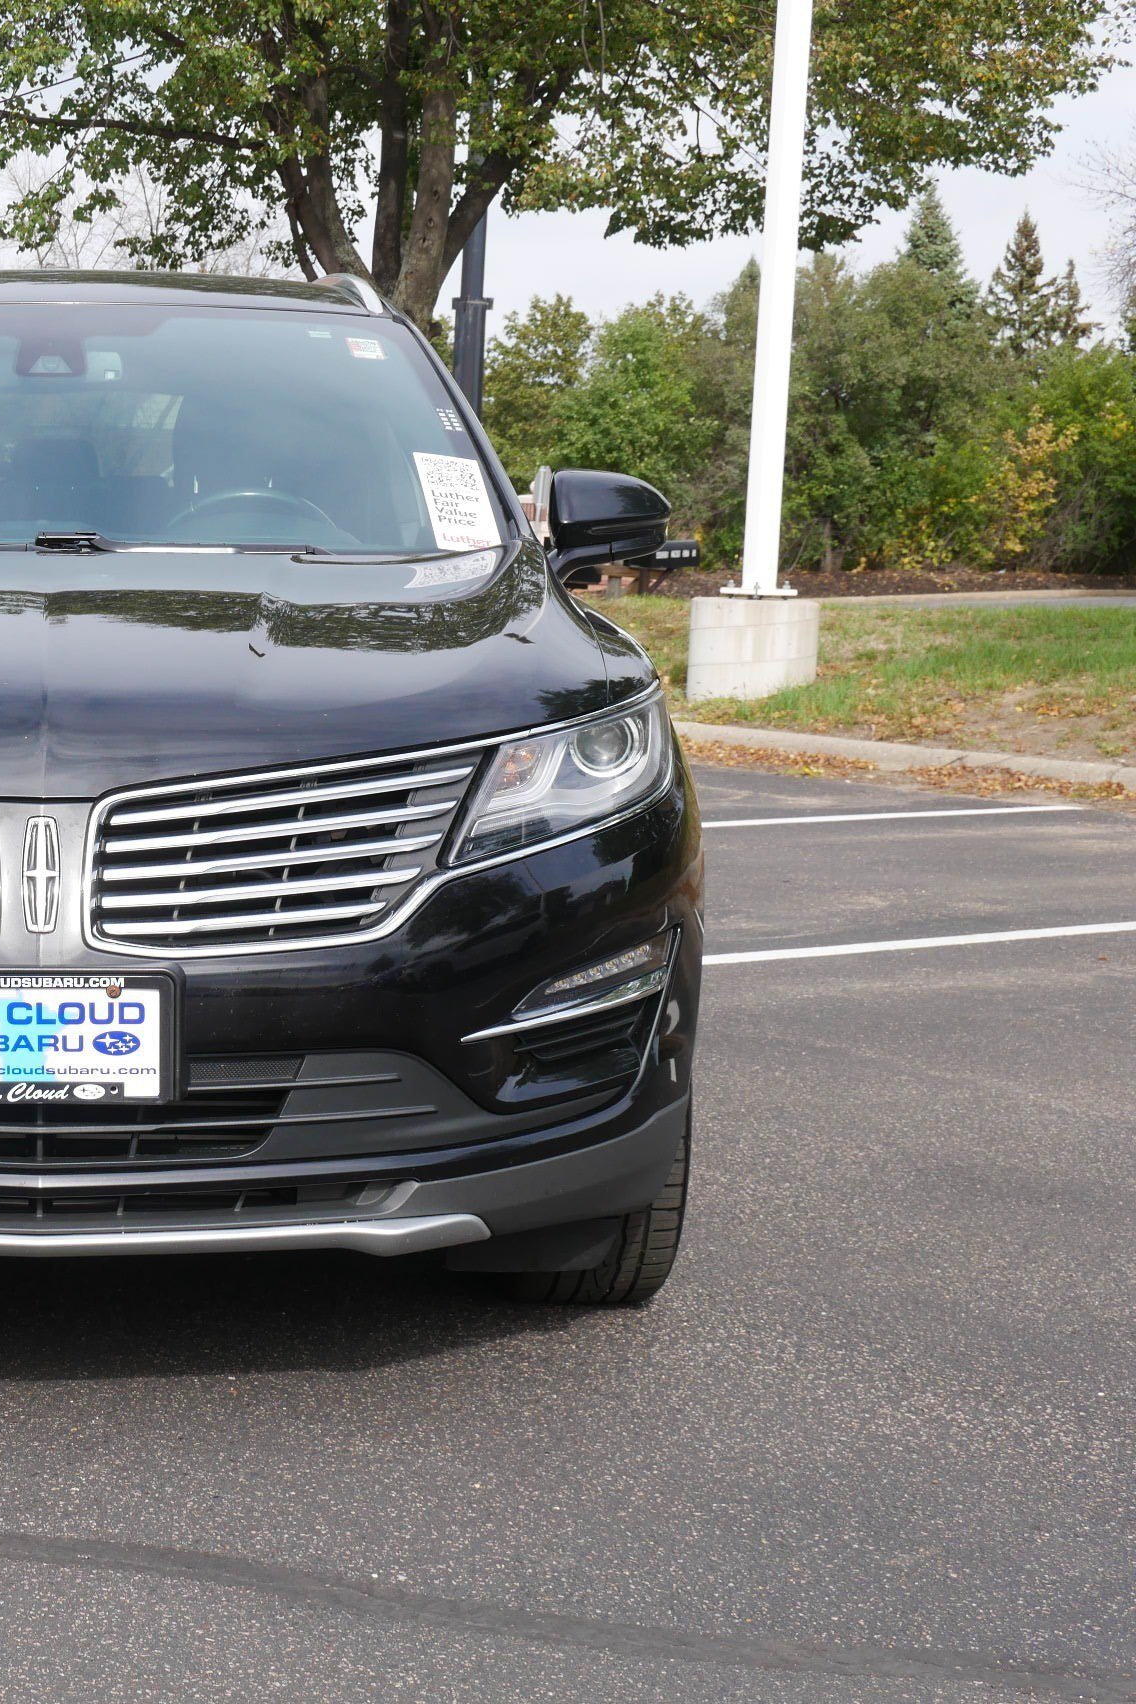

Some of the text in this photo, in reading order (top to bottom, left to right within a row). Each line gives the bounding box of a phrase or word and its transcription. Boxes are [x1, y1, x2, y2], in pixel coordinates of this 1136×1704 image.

[432, 489, 480, 502] Luther
[434, 498, 459, 507] Fair
[435, 506, 477, 519] Value
[438, 515, 476, 527] Price
[443, 532, 490, 547] Luther
[6, 1001, 146, 1026] CLOUD
[7, 1082, 70, 1102] Cloud
